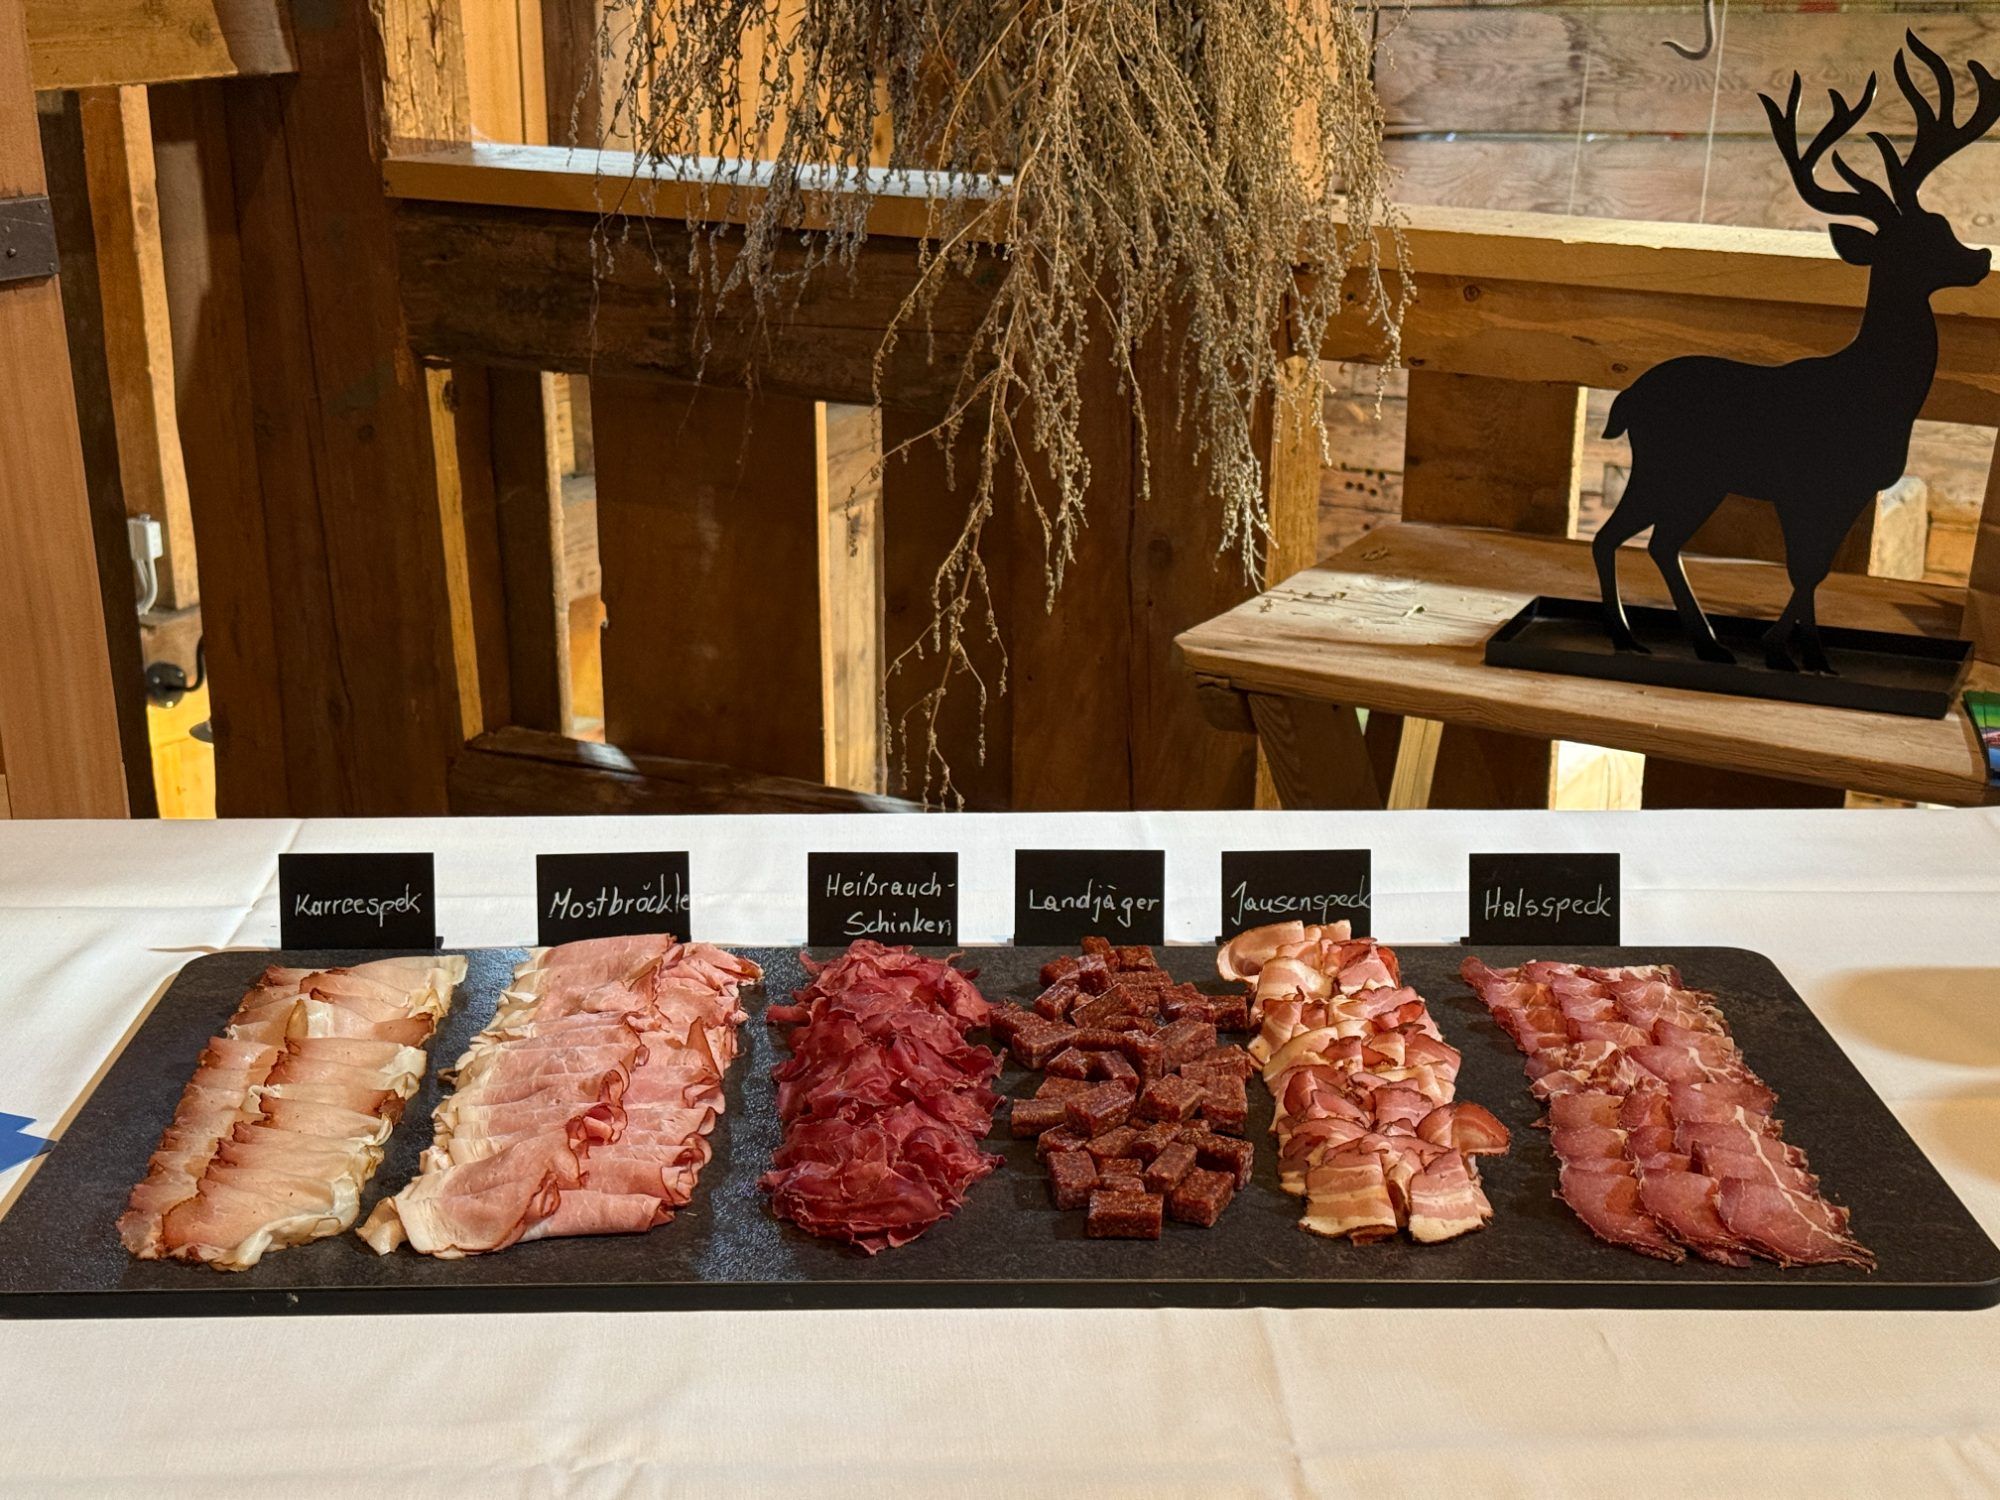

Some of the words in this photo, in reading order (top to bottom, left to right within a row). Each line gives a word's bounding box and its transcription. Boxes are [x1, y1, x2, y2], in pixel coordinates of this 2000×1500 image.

[843, 907, 952, 936] Schinken
[1029, 878, 1160, 928] Landjäger
[1230, 874, 1372, 927] Jausenspeck
[1485, 883, 1612, 923] Halsspeck
